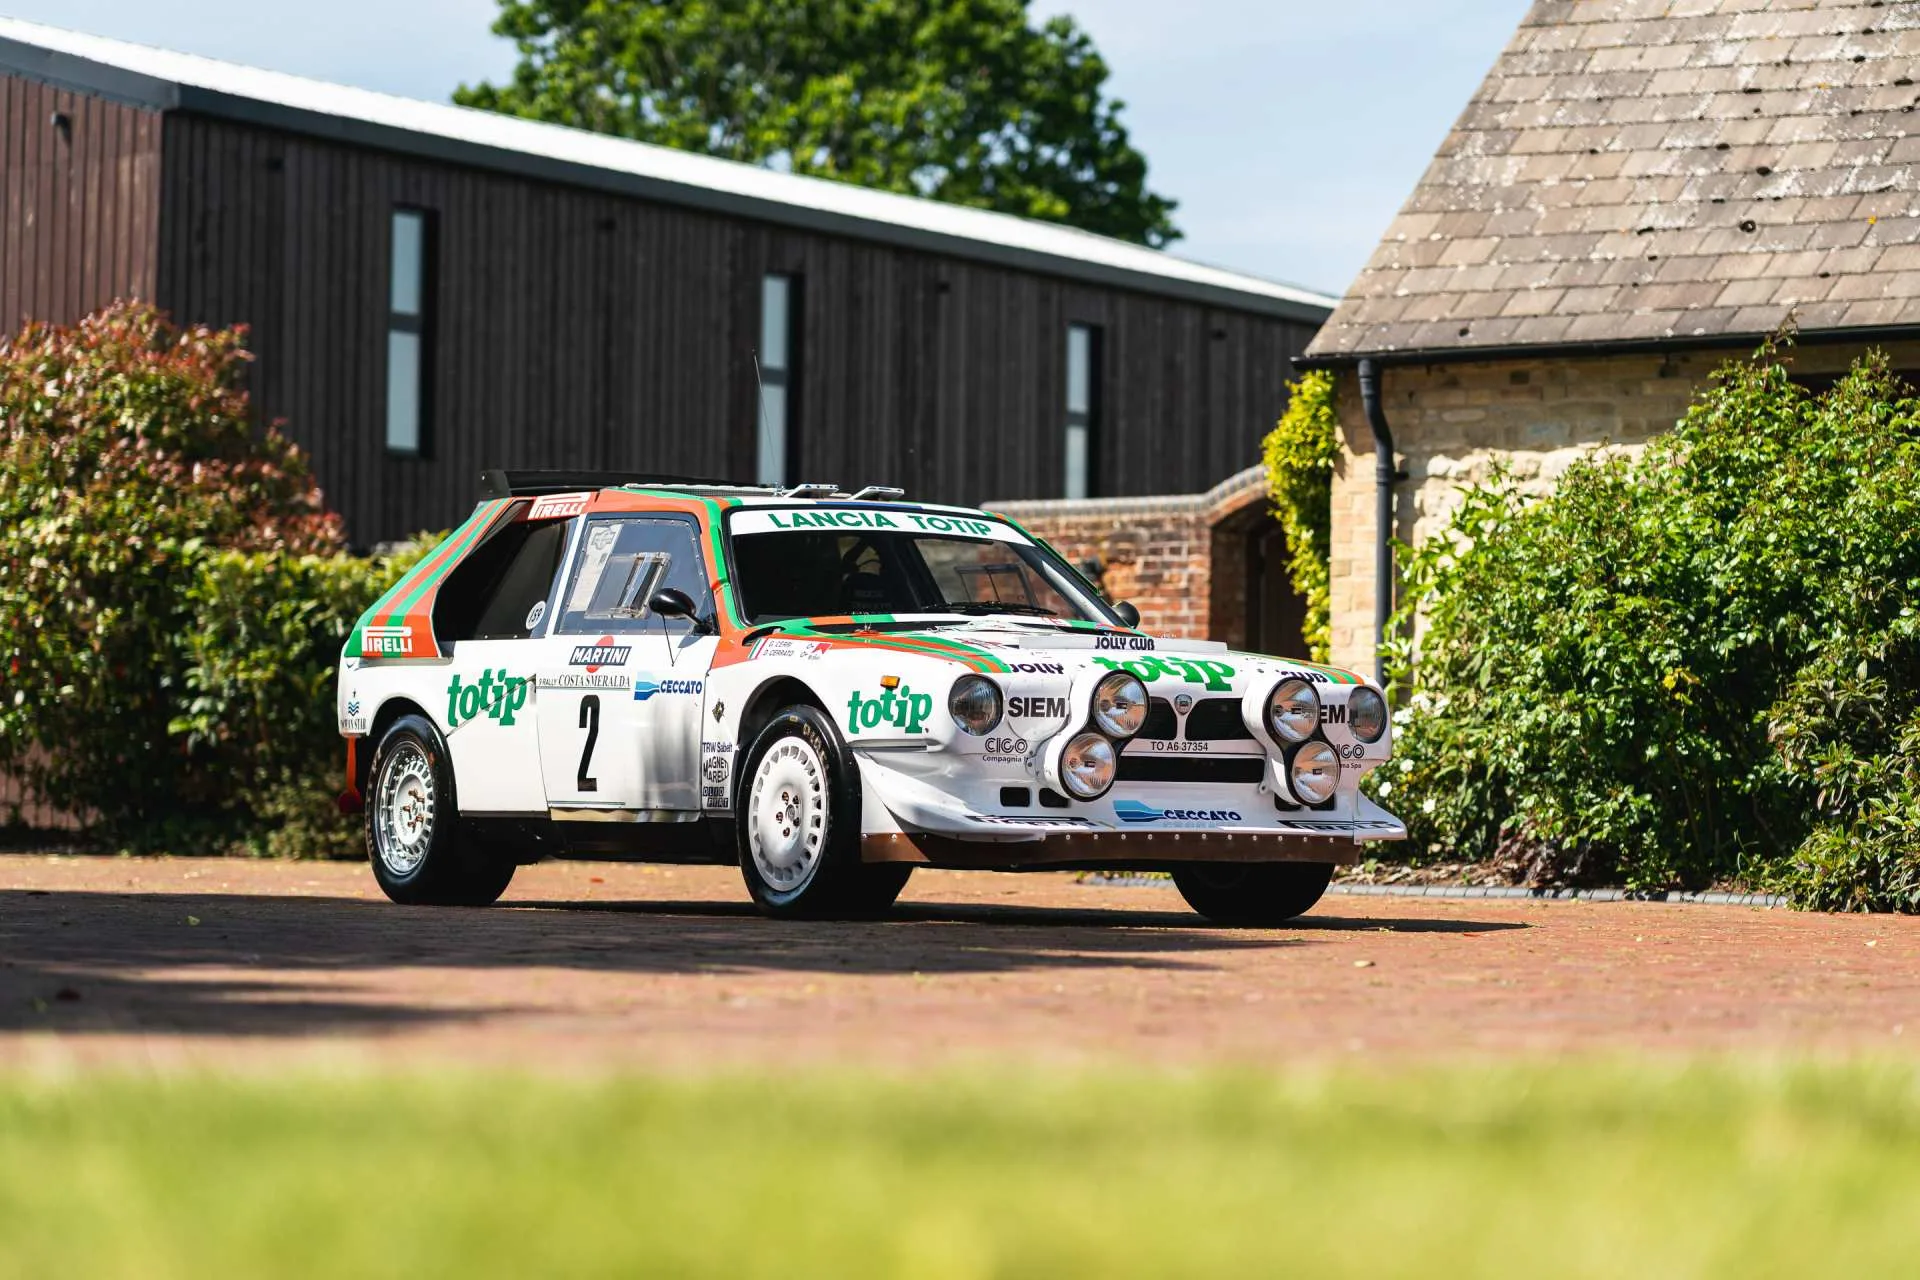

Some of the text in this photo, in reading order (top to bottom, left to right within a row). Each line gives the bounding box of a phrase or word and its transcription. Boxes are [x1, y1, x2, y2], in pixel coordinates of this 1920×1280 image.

[528, 493, 591, 519] PIRELLI
[768, 511, 992, 537] LANCIA TOTIP
[362, 626, 412, 653] PIRELLI
[1095, 636, 1155, 650] JOLLY CLUB
[571, 647, 630, 663] MARTINI
[1008, 663, 1064, 674] JOLLY
[1092, 656, 1235, 691] totip
[543, 677, 558, 687] RALLY
[558, 674, 585, 687] COSTA
[585, 674, 631, 688] SMERALDA
[660, 679, 703, 695] CECCATO
[447, 668, 527, 727] totip
[847, 685, 933, 735] totip
[1007, 697, 1066, 718] SIEM
[1320, 704, 1346, 724] EM
[577, 694, 601, 792] 2
[702, 742, 717, 753] TRW
[1150, 741, 1209, 752] TO A6 37354
[1336, 743, 1365, 759] IGO
[982, 754, 1022, 763] Compagnia
[1163, 809, 1242, 821] CECCATO
